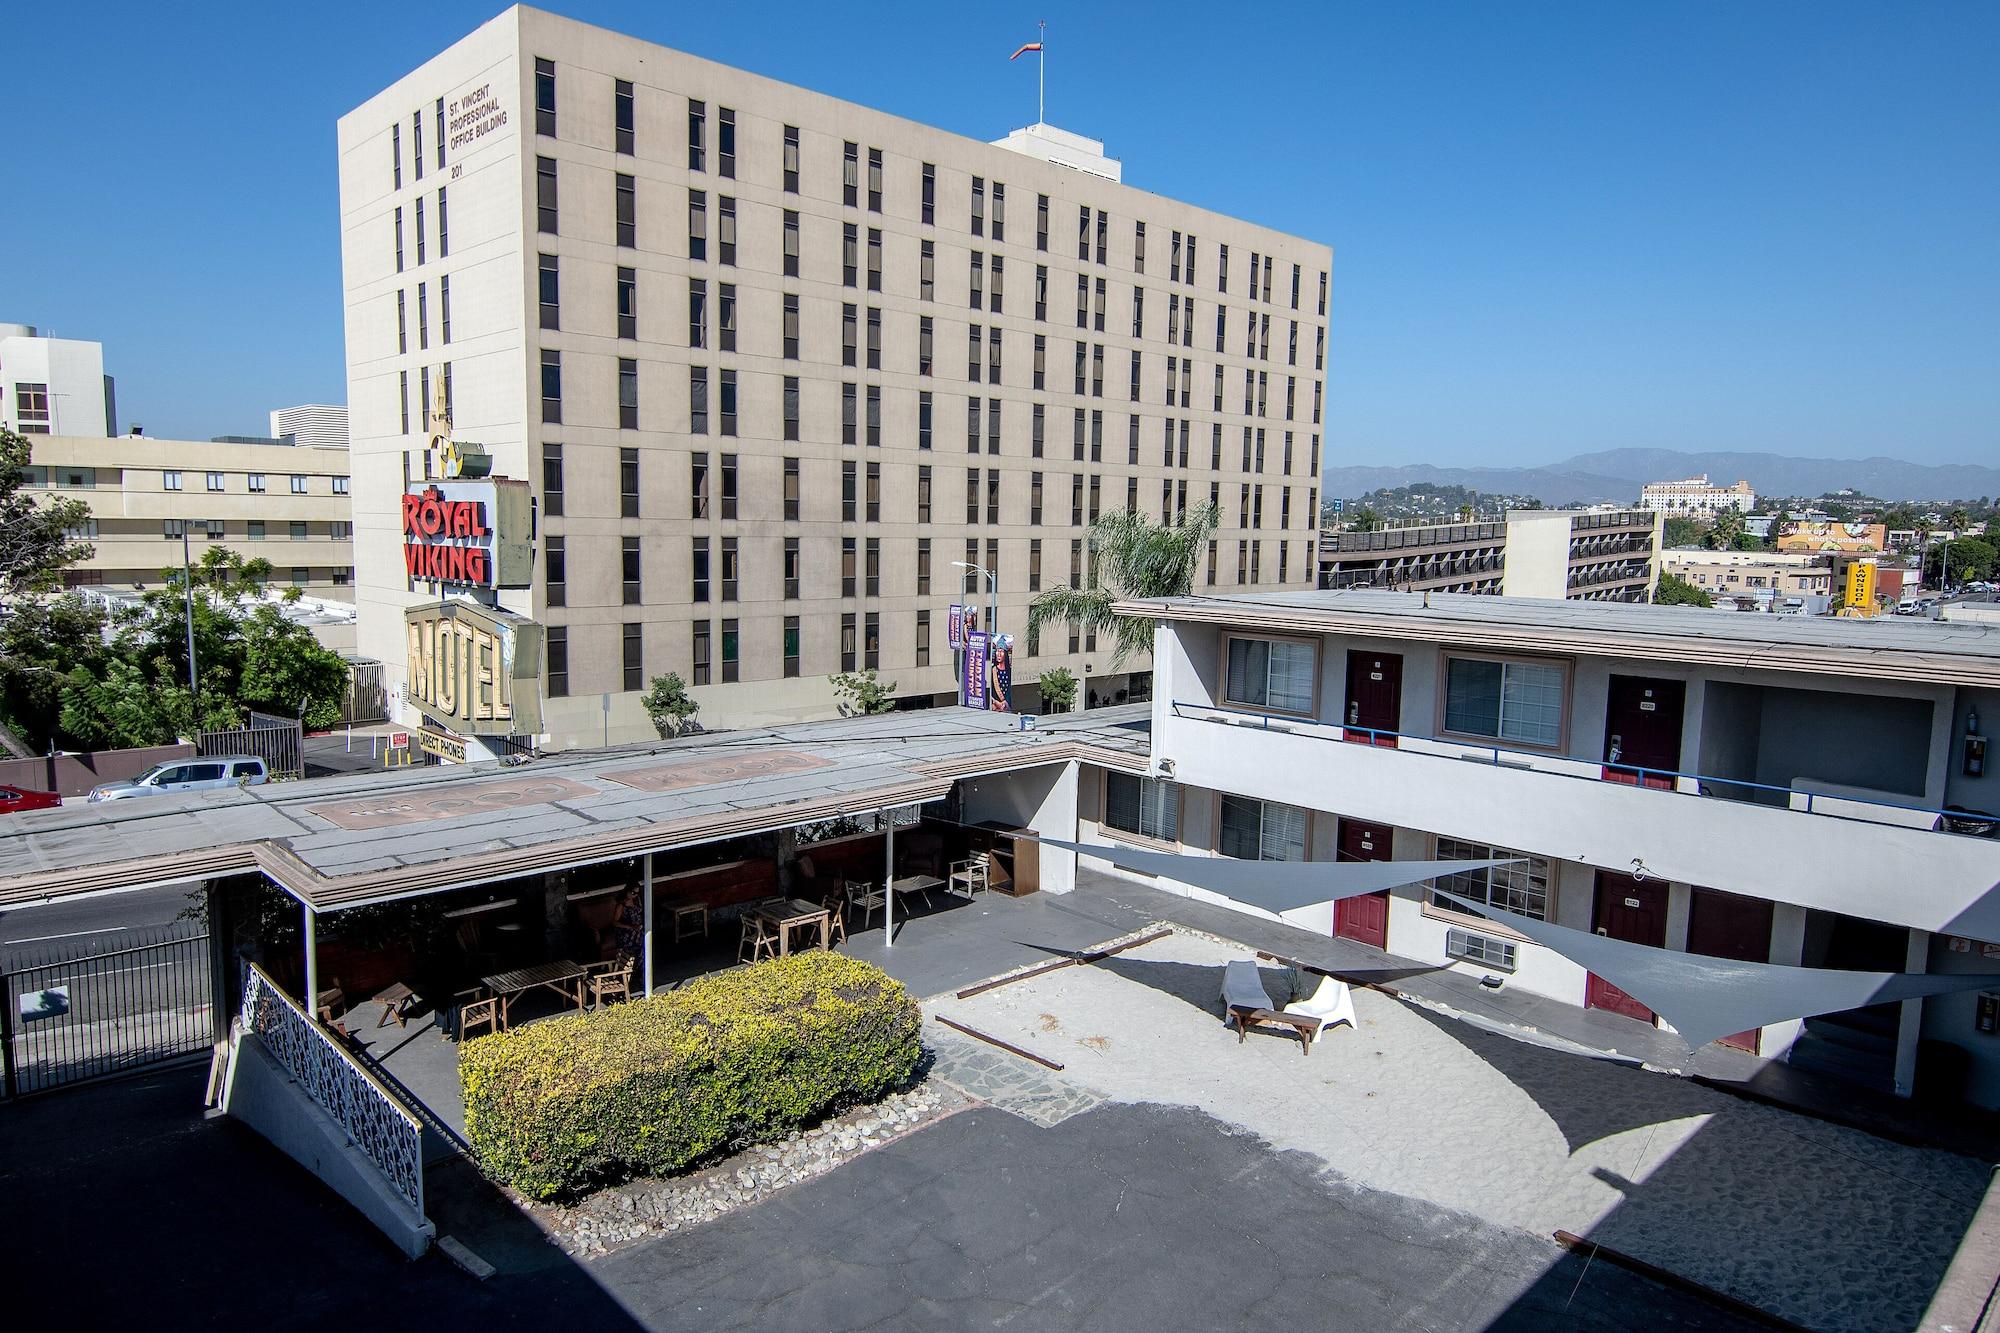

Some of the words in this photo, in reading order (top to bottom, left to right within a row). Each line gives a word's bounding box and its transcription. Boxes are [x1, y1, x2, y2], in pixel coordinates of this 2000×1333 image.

[449, 101, 459, 117] ST.
[461, 83, 490, 110] VINCENT
[449, 97, 499, 134] PROFESSIONAL
[450, 128, 474, 150] OFFICE
[475, 111, 507, 138] BUILDING
[451, 163, 463, 179] 201
[402, 494, 486, 541] ROYAL
[1788, 527, 1811, 535] Wake
[1813, 529, 1824, 537] up
[403, 543, 484, 584] VIKING
[408, 616, 511, 720] MOTEL
[968, 650, 976, 696] COUNTRY
[974, 651, 983, 697] INDIAN
[420, 732, 438, 752] DIRECT
[440, 739, 465, 760] PHONES
